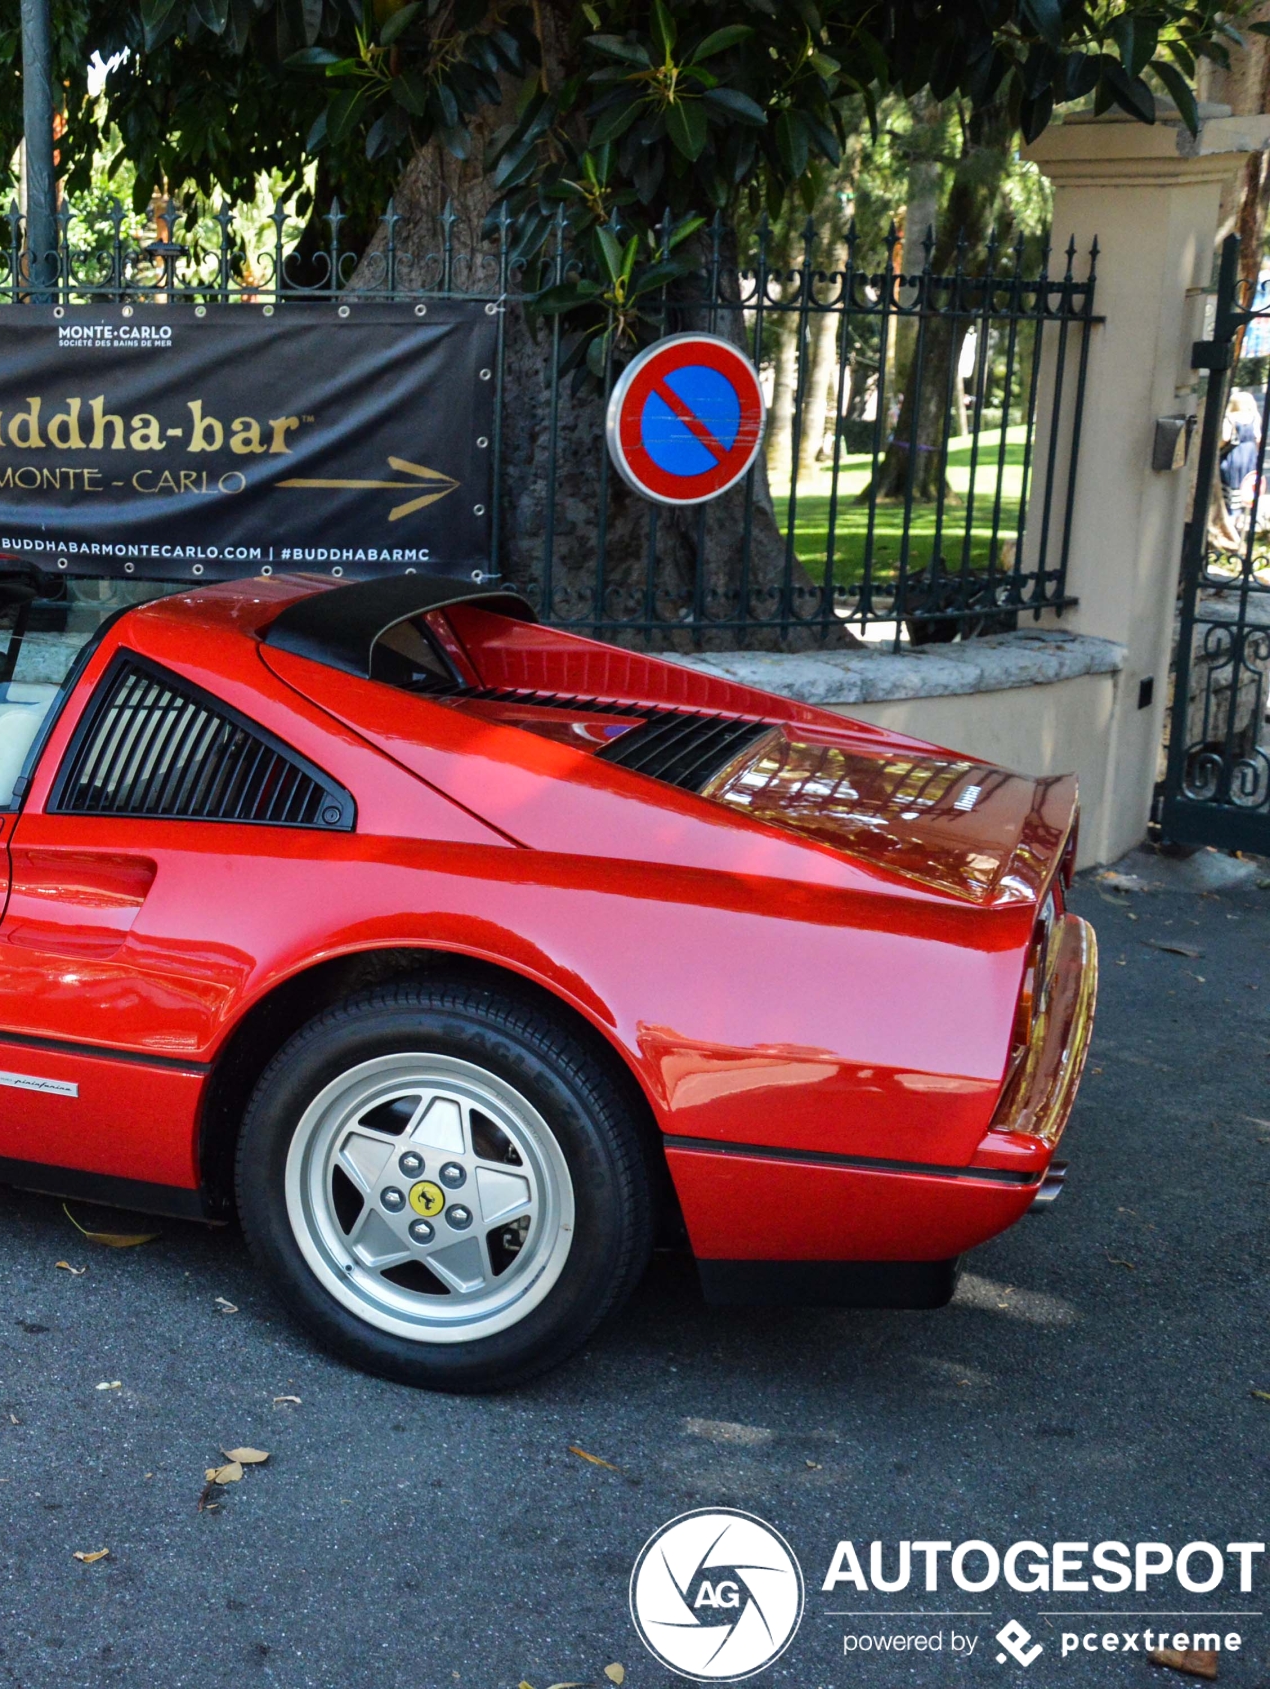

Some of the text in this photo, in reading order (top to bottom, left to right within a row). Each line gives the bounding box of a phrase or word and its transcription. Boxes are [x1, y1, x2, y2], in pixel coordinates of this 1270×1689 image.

[132, 470, 246, 494] CARLO
[2, 538, 261, 559] BUDDHABARMONTECARLO.COM
[281, 548, 429, 561] #BUDDHABARMC
